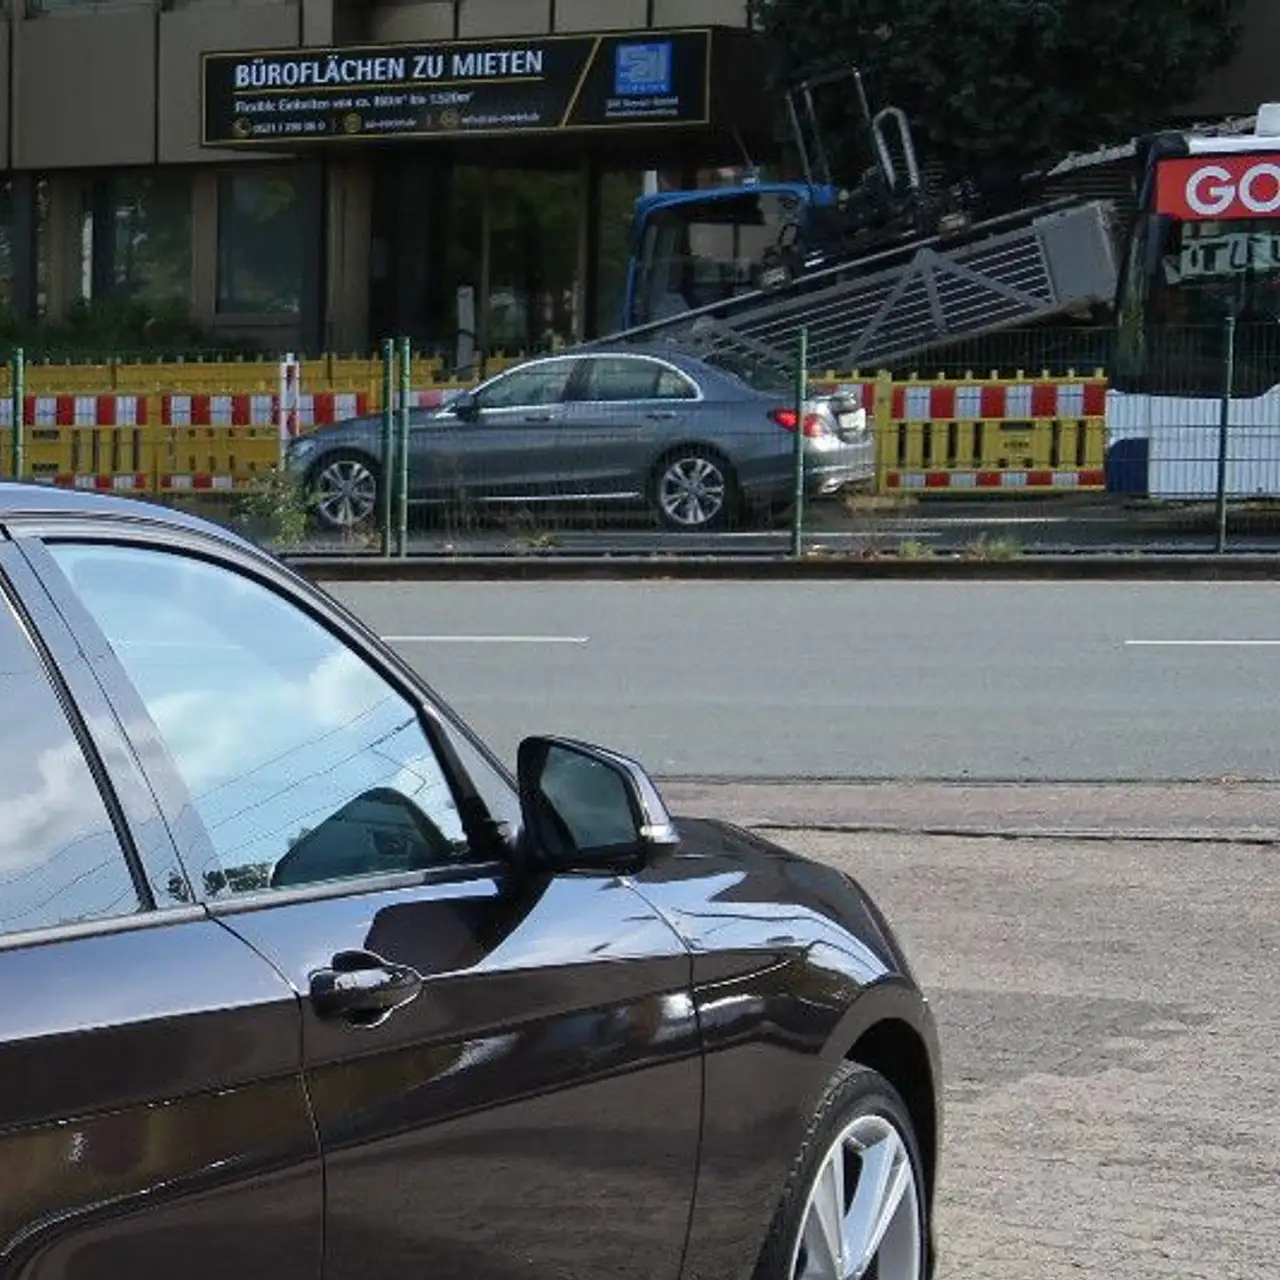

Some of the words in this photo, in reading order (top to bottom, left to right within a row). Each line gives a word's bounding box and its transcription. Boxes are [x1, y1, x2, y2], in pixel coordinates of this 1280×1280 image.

[234, 55, 405, 88] BÜROFLÄCHEN
[412, 55, 444, 79] ZU
[451, 50, 544, 76] MIETEN
